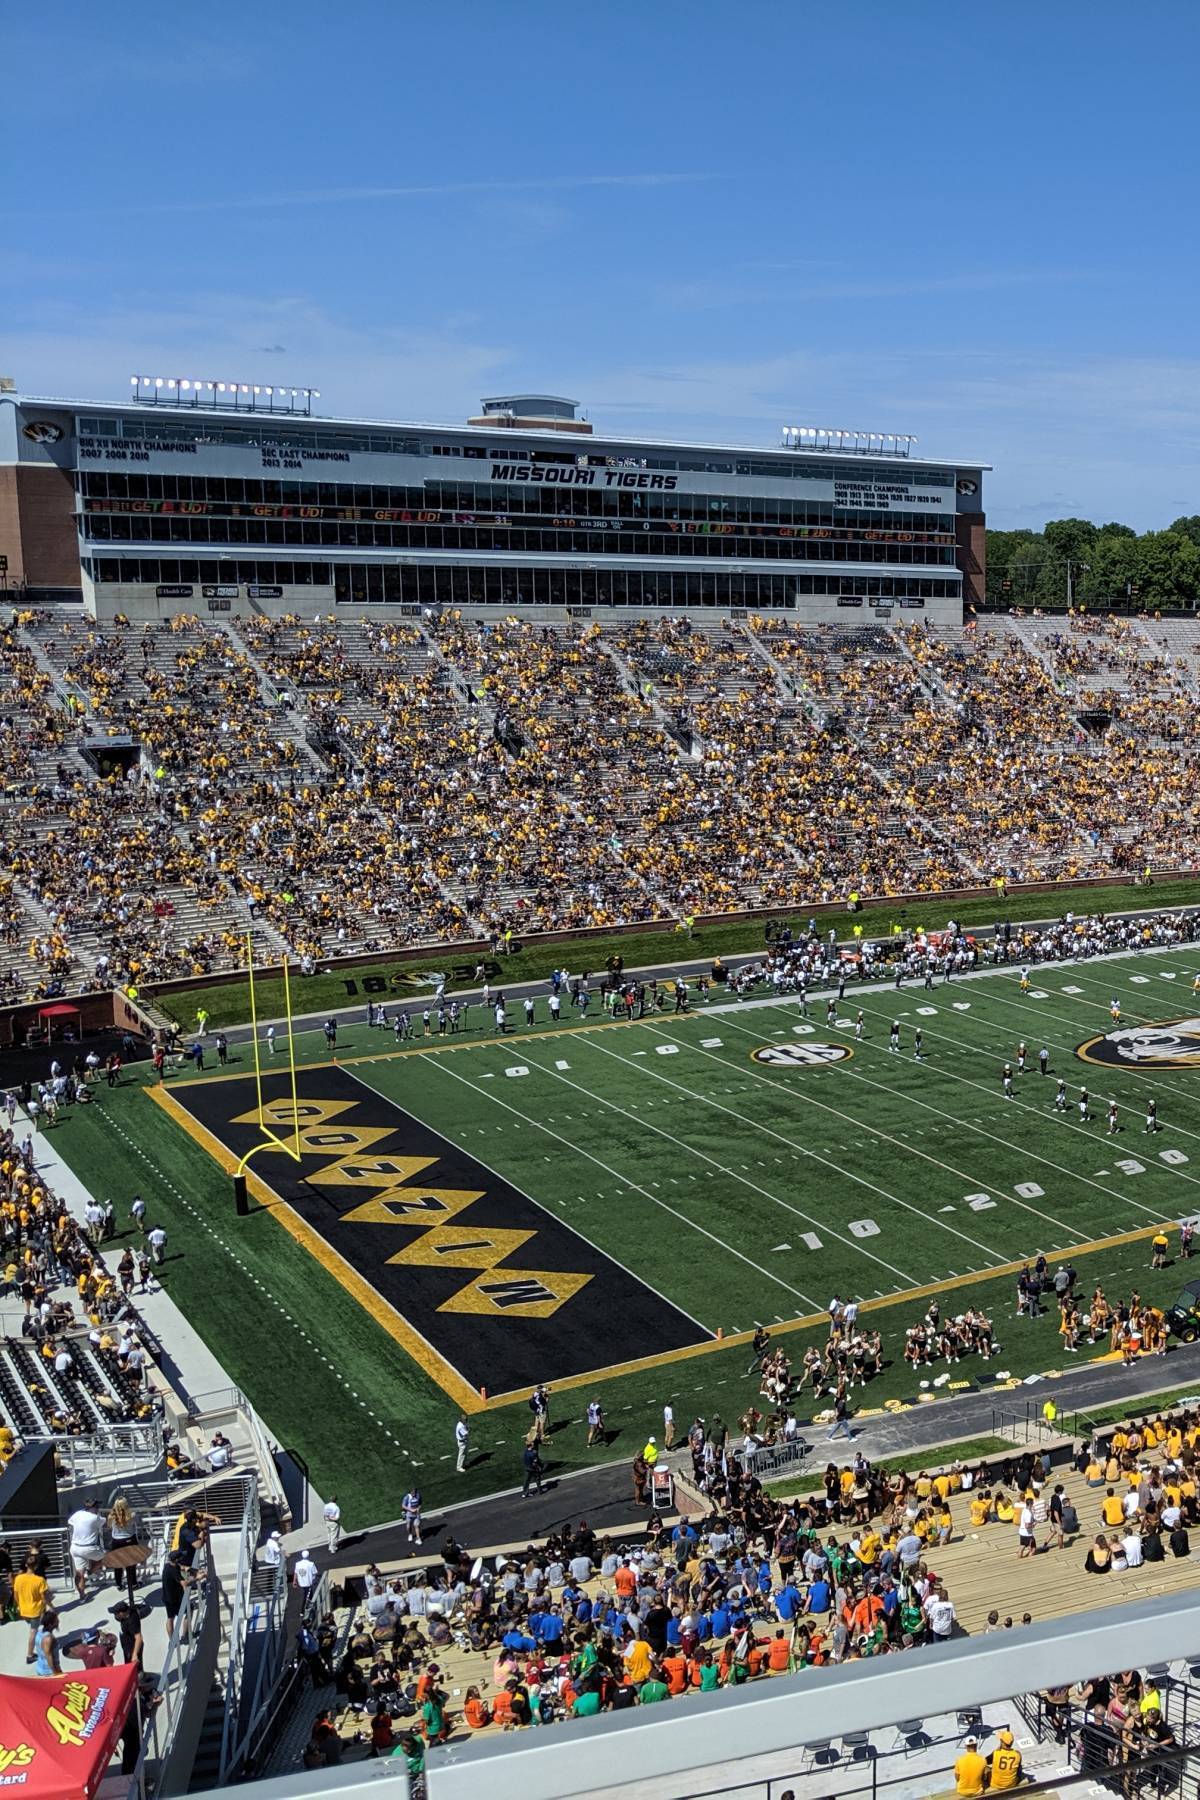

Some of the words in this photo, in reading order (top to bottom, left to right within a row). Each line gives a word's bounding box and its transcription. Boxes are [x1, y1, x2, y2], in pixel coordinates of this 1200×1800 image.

[111, 440, 143, 450] NORTH
[144, 441, 197, 454] CHAMPIONS
[80, 449, 102, 459] 2007
[105, 450, 128, 460] 2008
[130, 451, 149, 461] 2010
[261, 448, 277, 457] SEC
[279, 449, 300, 459] EAST
[301, 451, 350, 462] CHAMPIONS
[262, 459, 280, 467] 2013
[283, 460, 302, 468] 2014
[491, 464, 596, 485] MISSOURI
[605, 471, 678, 490] TIGERS
[835, 483, 873, 492] CONFERENCE
[873, 484, 909, 494] CHAMPIONS
[254, 507, 280, 516] GET
[374, 511, 400, 520] GET
[495, 516, 507, 525] 31
[90, 1687, 111, 1714] Custard
[46, 1681, 92, 1746] Andy's
[79, 1711, 101, 1738] Frozen
[0, 1743, 36, 1773] y's
[998, 1756, 1016, 1771] 67
